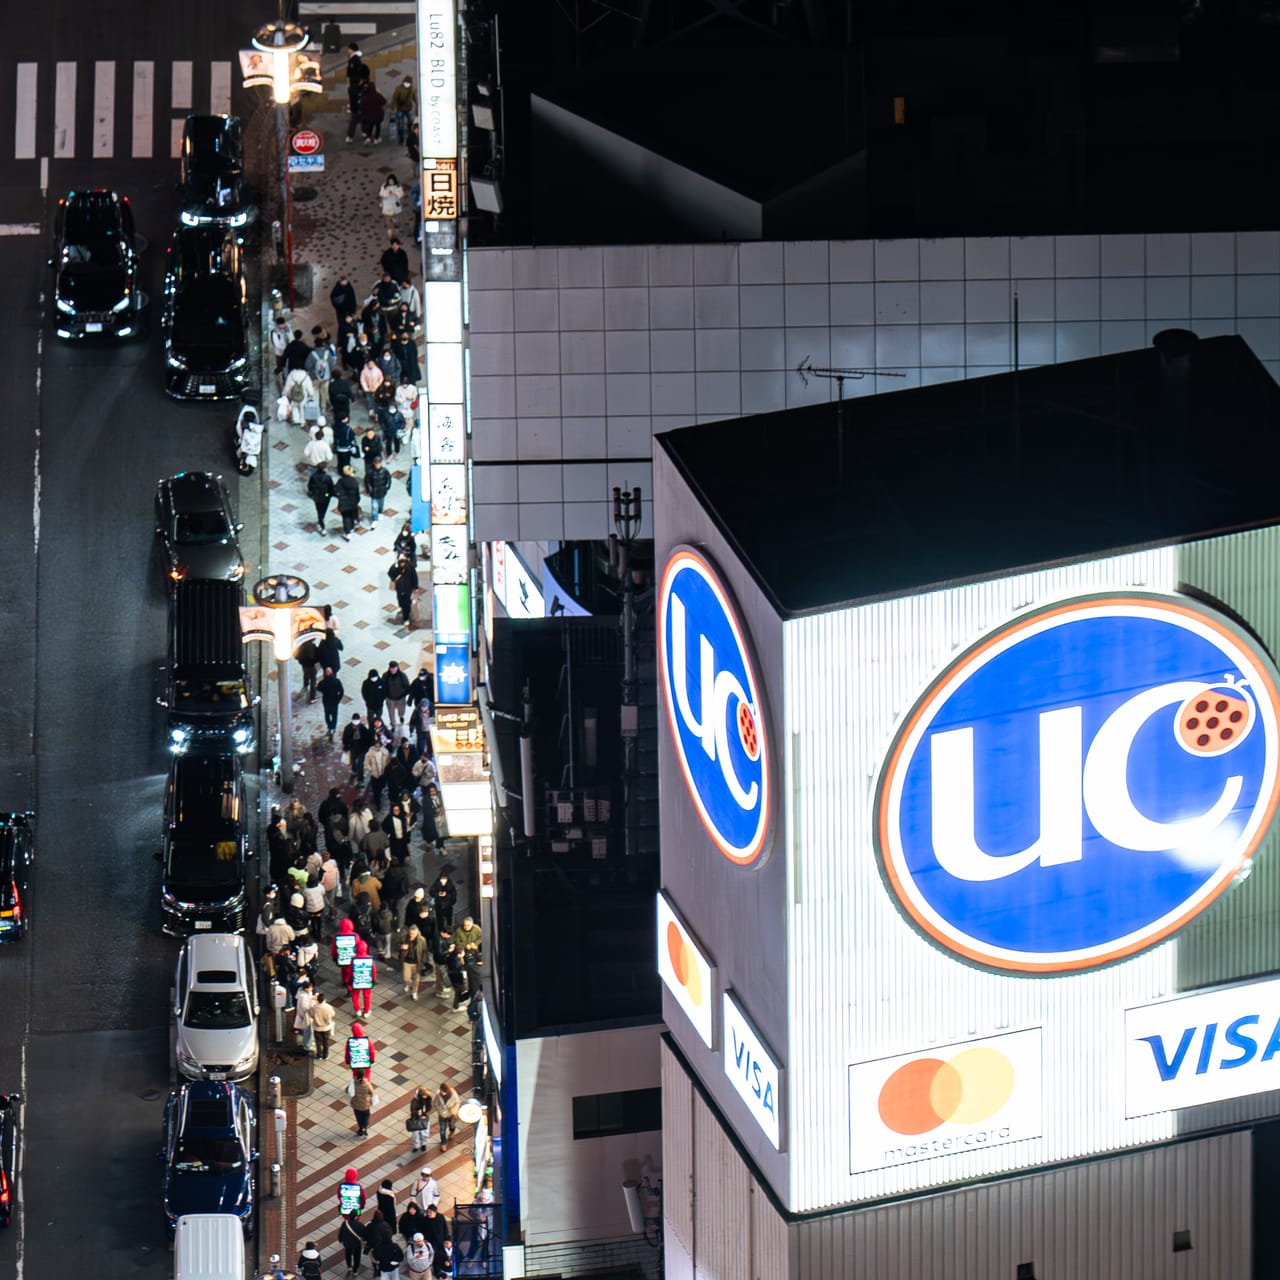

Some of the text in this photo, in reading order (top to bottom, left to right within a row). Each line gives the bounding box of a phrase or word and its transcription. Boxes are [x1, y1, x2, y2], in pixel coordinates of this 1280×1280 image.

[428, 172, 455, 216] 日焼
[730, 1026, 777, 1118] VISA
[884, 1123, 1013, 1163] mastercard
